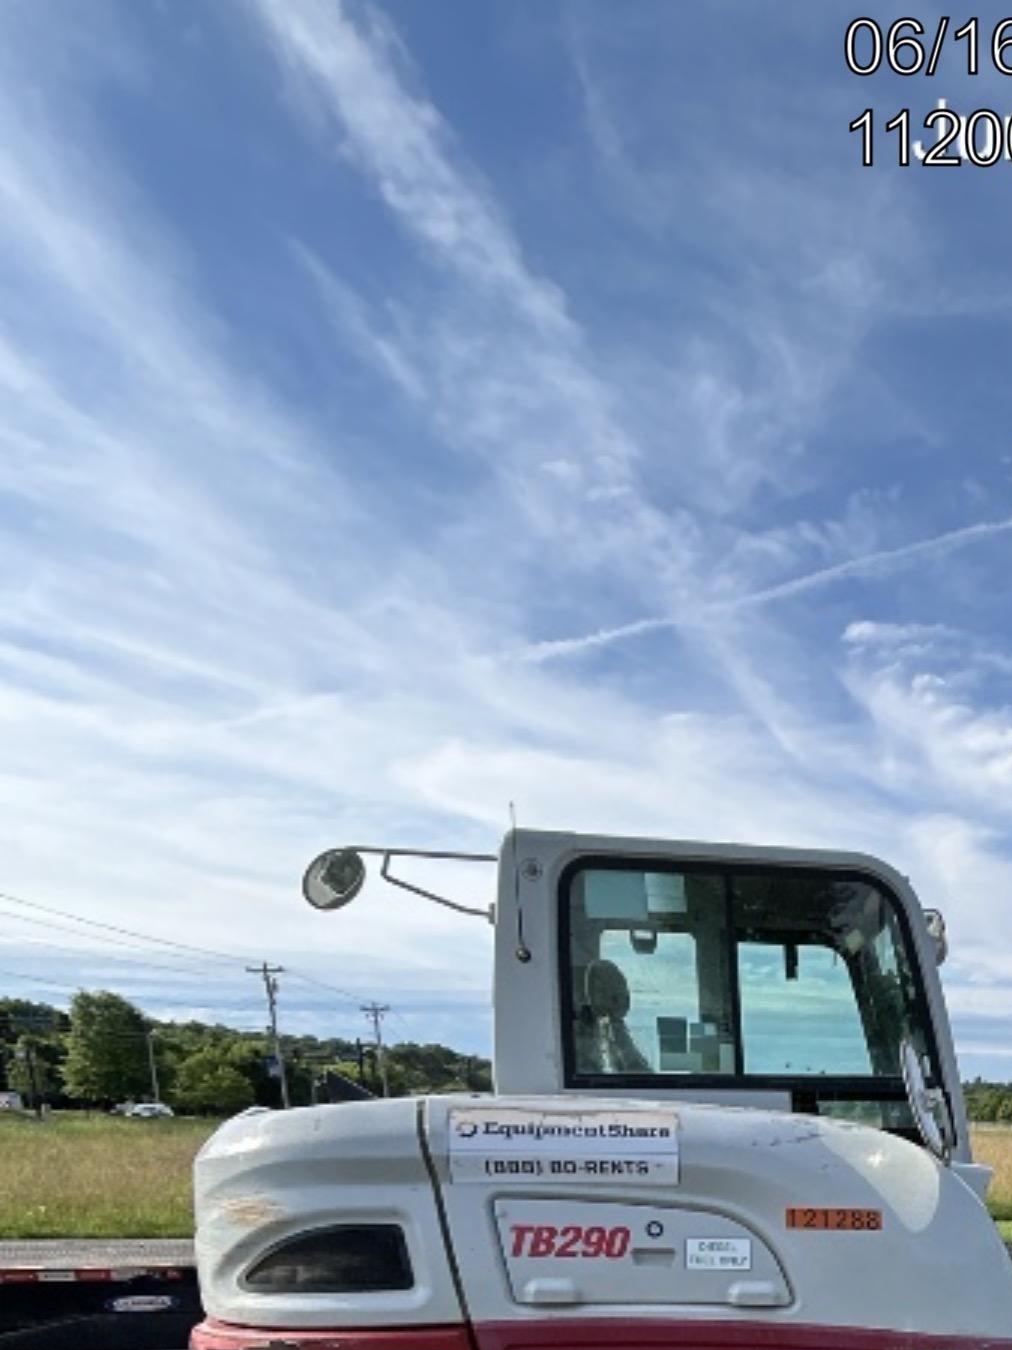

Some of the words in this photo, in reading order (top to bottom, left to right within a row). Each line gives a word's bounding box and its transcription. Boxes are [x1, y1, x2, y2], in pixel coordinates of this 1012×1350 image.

[482, 1121, 670, 1140] EquipmentShare
[788, 1208, 881, 1230] 121288
[510, 1224, 631, 1258] TB290
